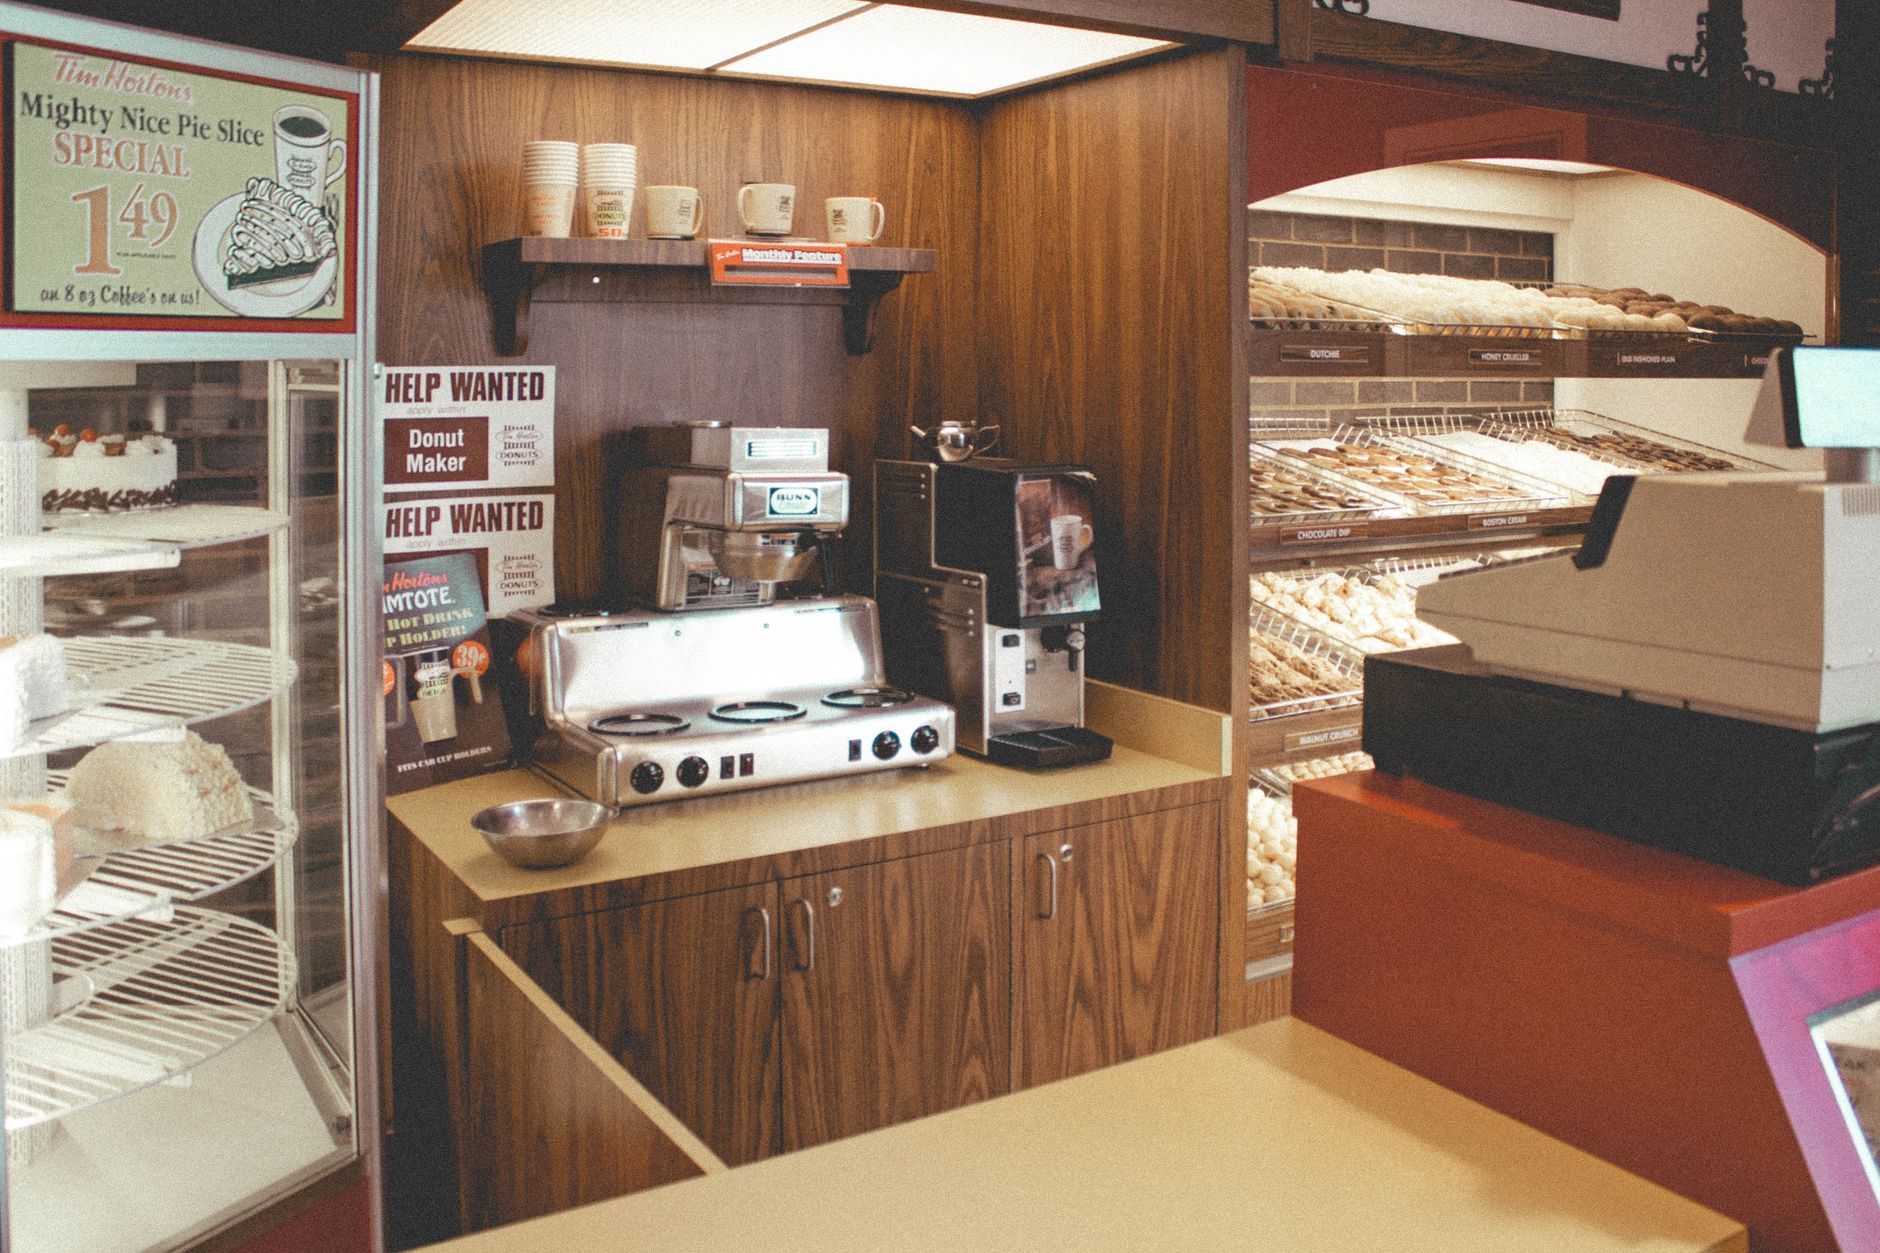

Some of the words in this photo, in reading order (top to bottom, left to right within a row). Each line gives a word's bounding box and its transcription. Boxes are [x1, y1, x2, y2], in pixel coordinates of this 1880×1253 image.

[54, 54, 98, 87] Tim
[103, 59, 191, 101] Hortons
[21, 91, 113, 133] Mighty
[120, 105, 170, 135] Nice
[178, 113, 210, 140] Pie
[217, 119, 264, 147] Slice
[54, 132, 190, 178] SPECIAL
[742, 248, 792, 262] Monthly
[794, 250, 842, 264] Feature
[41, 289, 60, 301] an
[64, 284, 75, 302] 8
[79, 289, 96, 306] oz
[101, 284, 156, 306] Coffee's
[161, 292, 177, 304] on
[181, 289, 200, 305] us!
[1310, 350, 1340, 358] DUTCHIE
[1481, 352, 1501, 361] HONEY
[1622, 355, 1632, 363] OLD
[1633, 355, 1661, 363] FASHIONED
[385, 373, 441, 403] HELP
[450, 372, 545, 402] WANTED
[406, 407, 432, 415] apply
[438, 406, 466, 414] within
[409, 428, 465, 449] Donut
[406, 453, 467, 473] Maker
[500, 451, 538, 459] DONUTS
[385, 505, 441, 538] HELP
[450, 501, 544, 535] WANTED
[1483, 517, 1507, 527] BOSTON
[1508, 516, 1528, 525] CREAM
[1297, 530, 1337, 541] CHOCOLATE
[1339, 528, 1350, 538] DIP
[392, 571, 448, 592] Hortons
[500, 580, 539, 589] DONUTS
[423, 607, 474, 625] DRINK
[399, 625, 466, 646] HOLDER!
[1300, 732, 1328, 746] WALNUT
[1329, 727, 1359, 740] CRUNCH
[397, 761, 418, 773] FITS
[418, 757, 436, 768] CAR
[437, 754, 453, 764] CUP
[453, 746, 492, 760] HOLDERS
